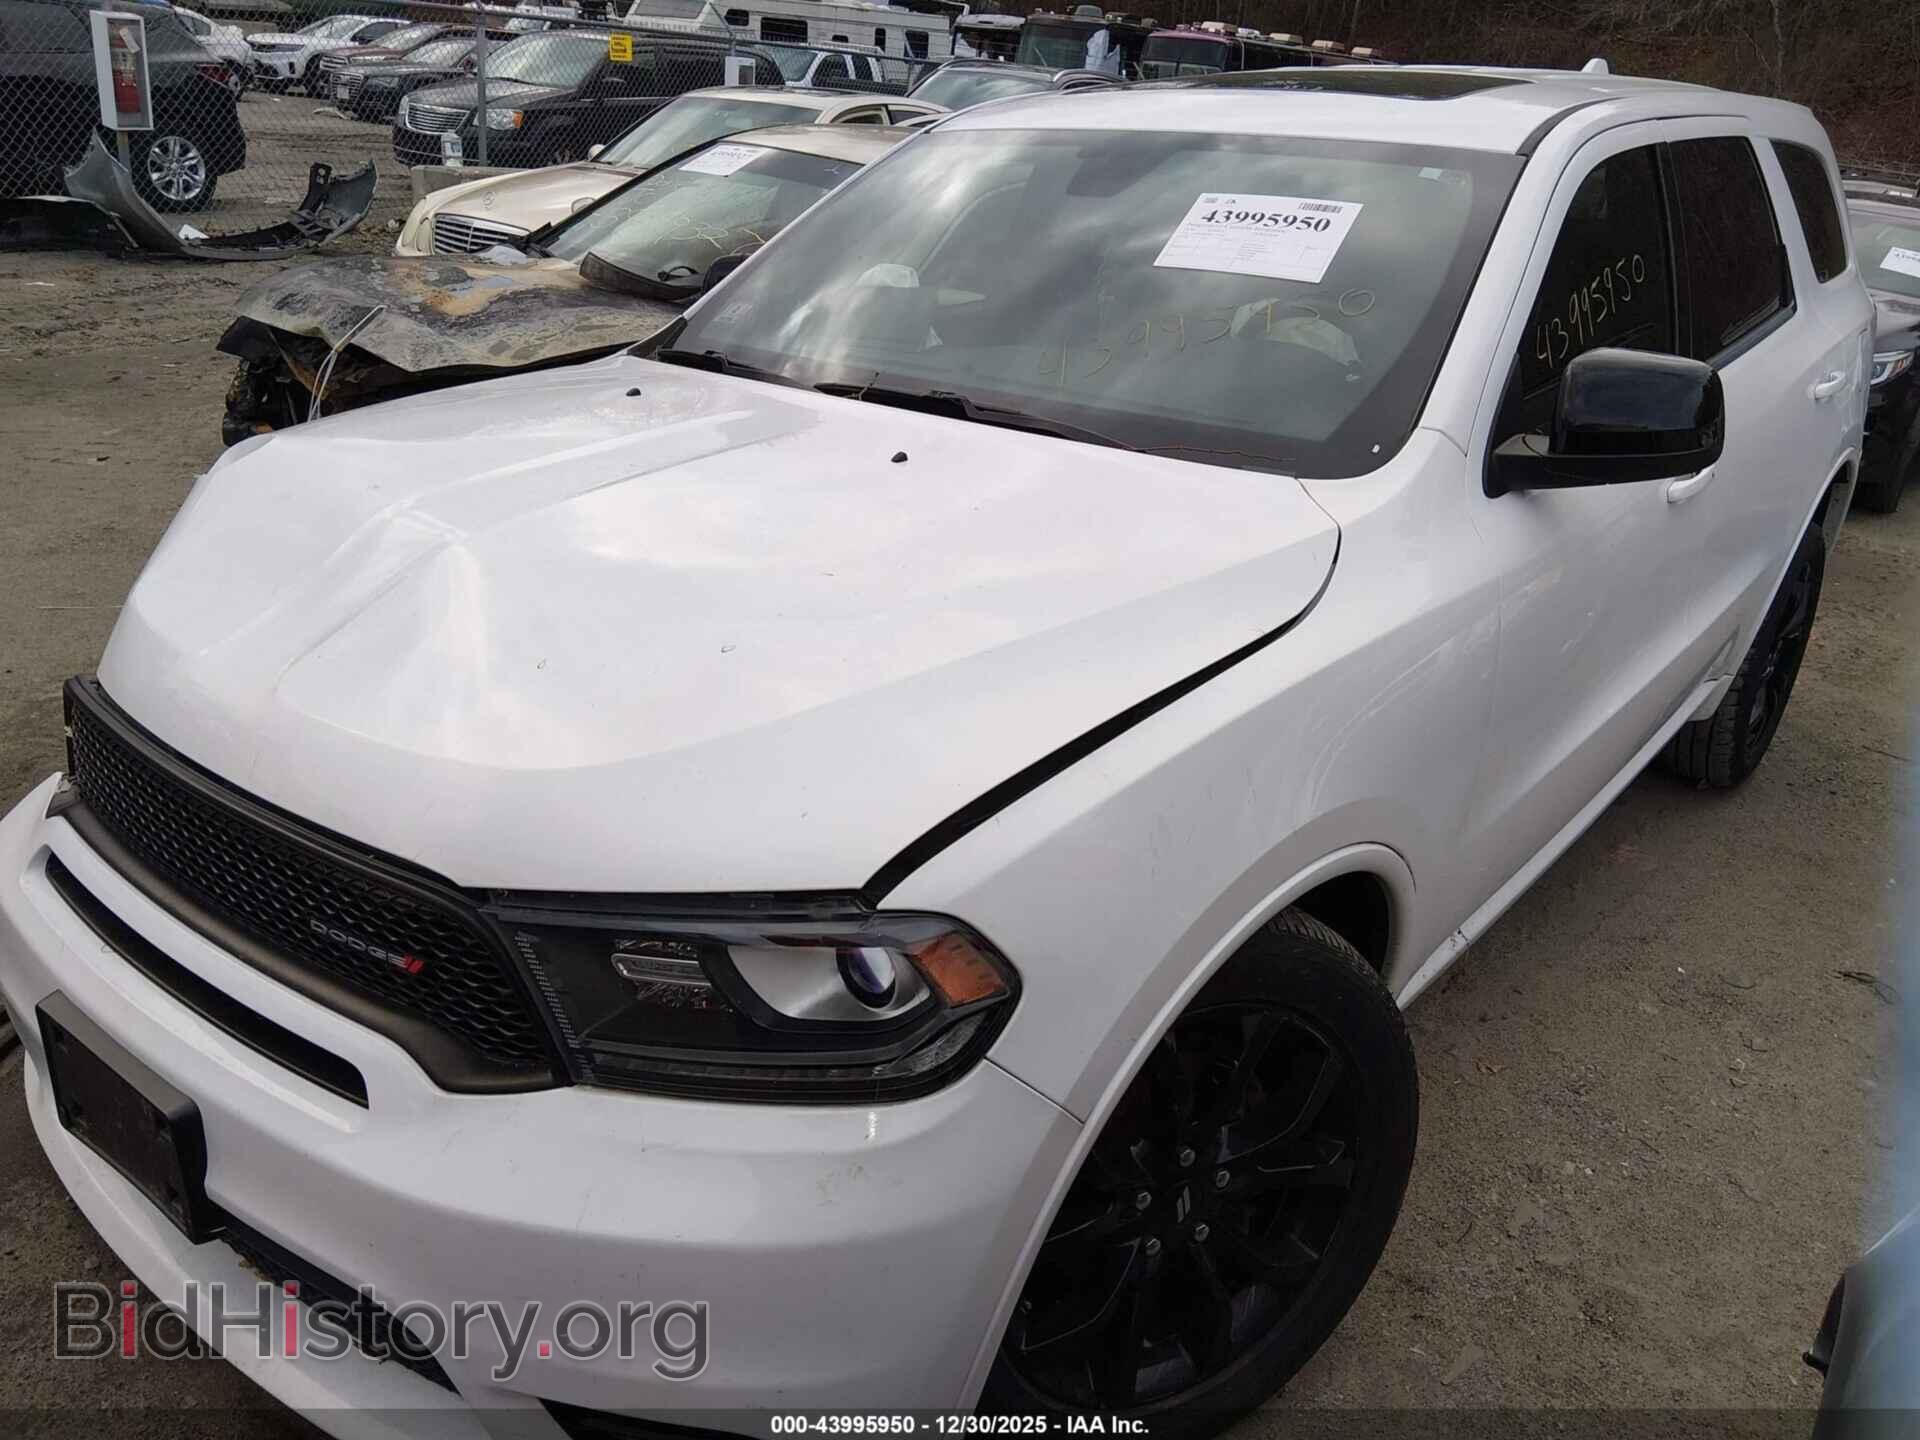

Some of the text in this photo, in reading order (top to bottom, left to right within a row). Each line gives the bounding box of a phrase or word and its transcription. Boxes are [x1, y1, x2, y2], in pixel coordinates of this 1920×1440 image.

[1201, 209, 1331, 232] 43995950
[1536, 254, 1645, 369] 43995950
[310, 919, 408, 968] DODGE
